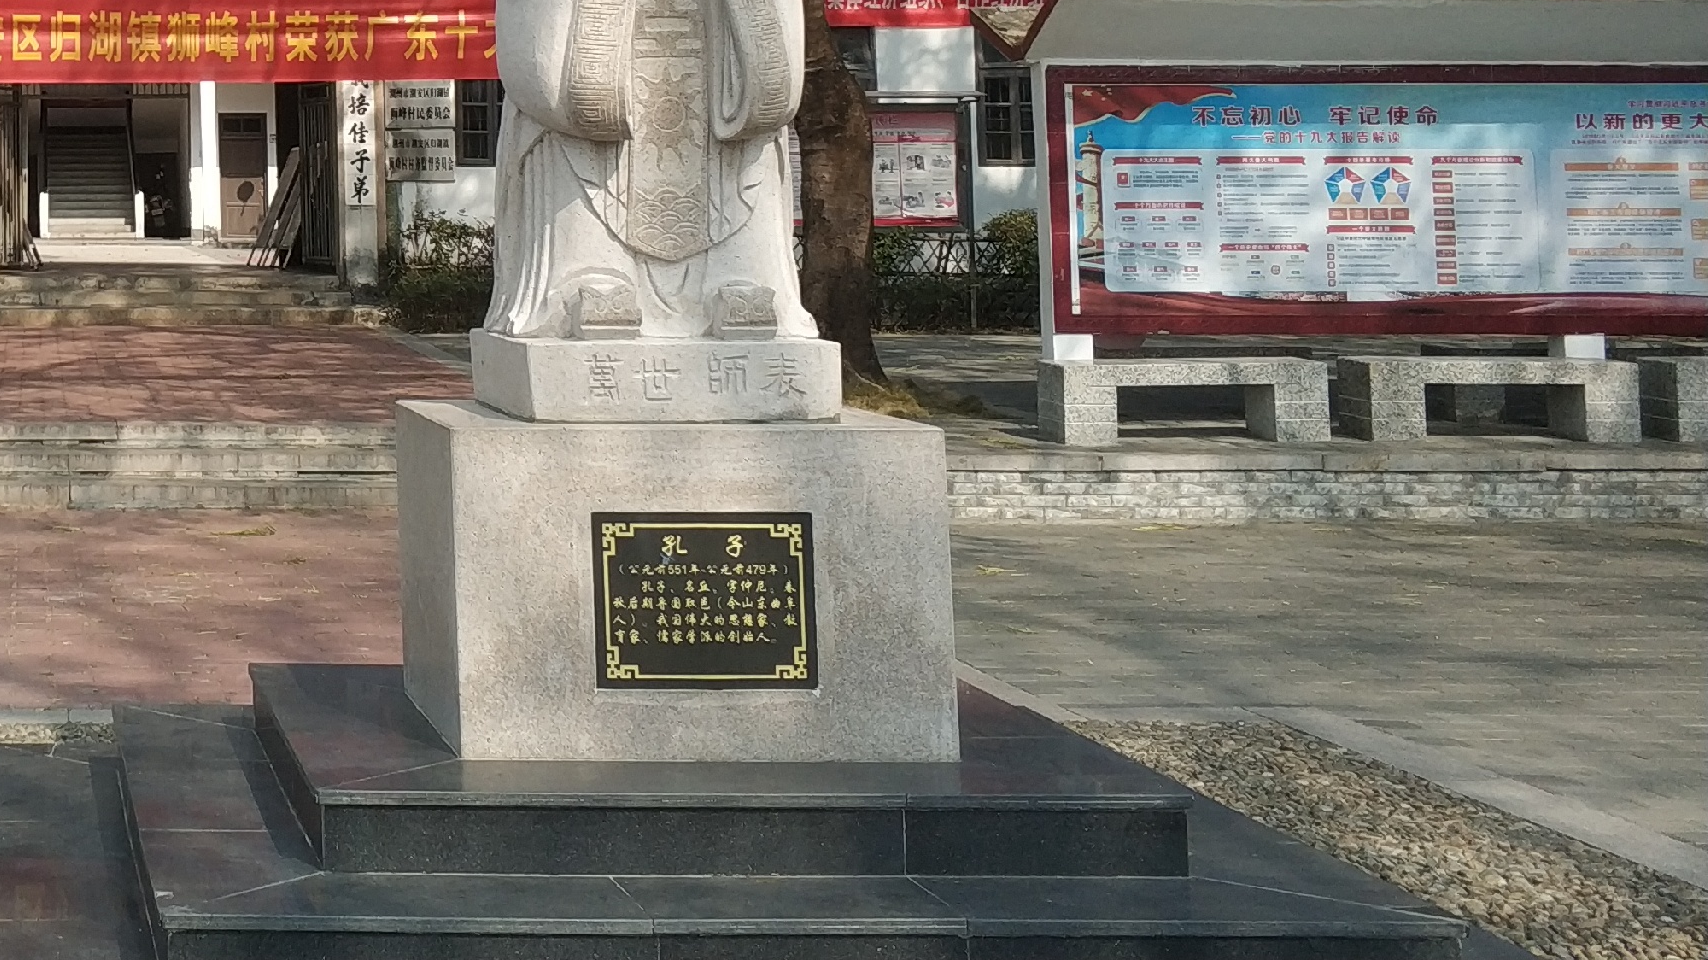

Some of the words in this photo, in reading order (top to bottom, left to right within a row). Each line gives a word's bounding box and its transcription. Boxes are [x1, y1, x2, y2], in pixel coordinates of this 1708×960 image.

[1192, 105, 1302, 127] 不忘初心
[1329, 105, 1440, 127] 牢记使命
[1576, 113, 1708, 130] 以新的更大
[347, 81, 370, 203] 培佳子弟
[583, 351, 807, 402] 萬世師表
